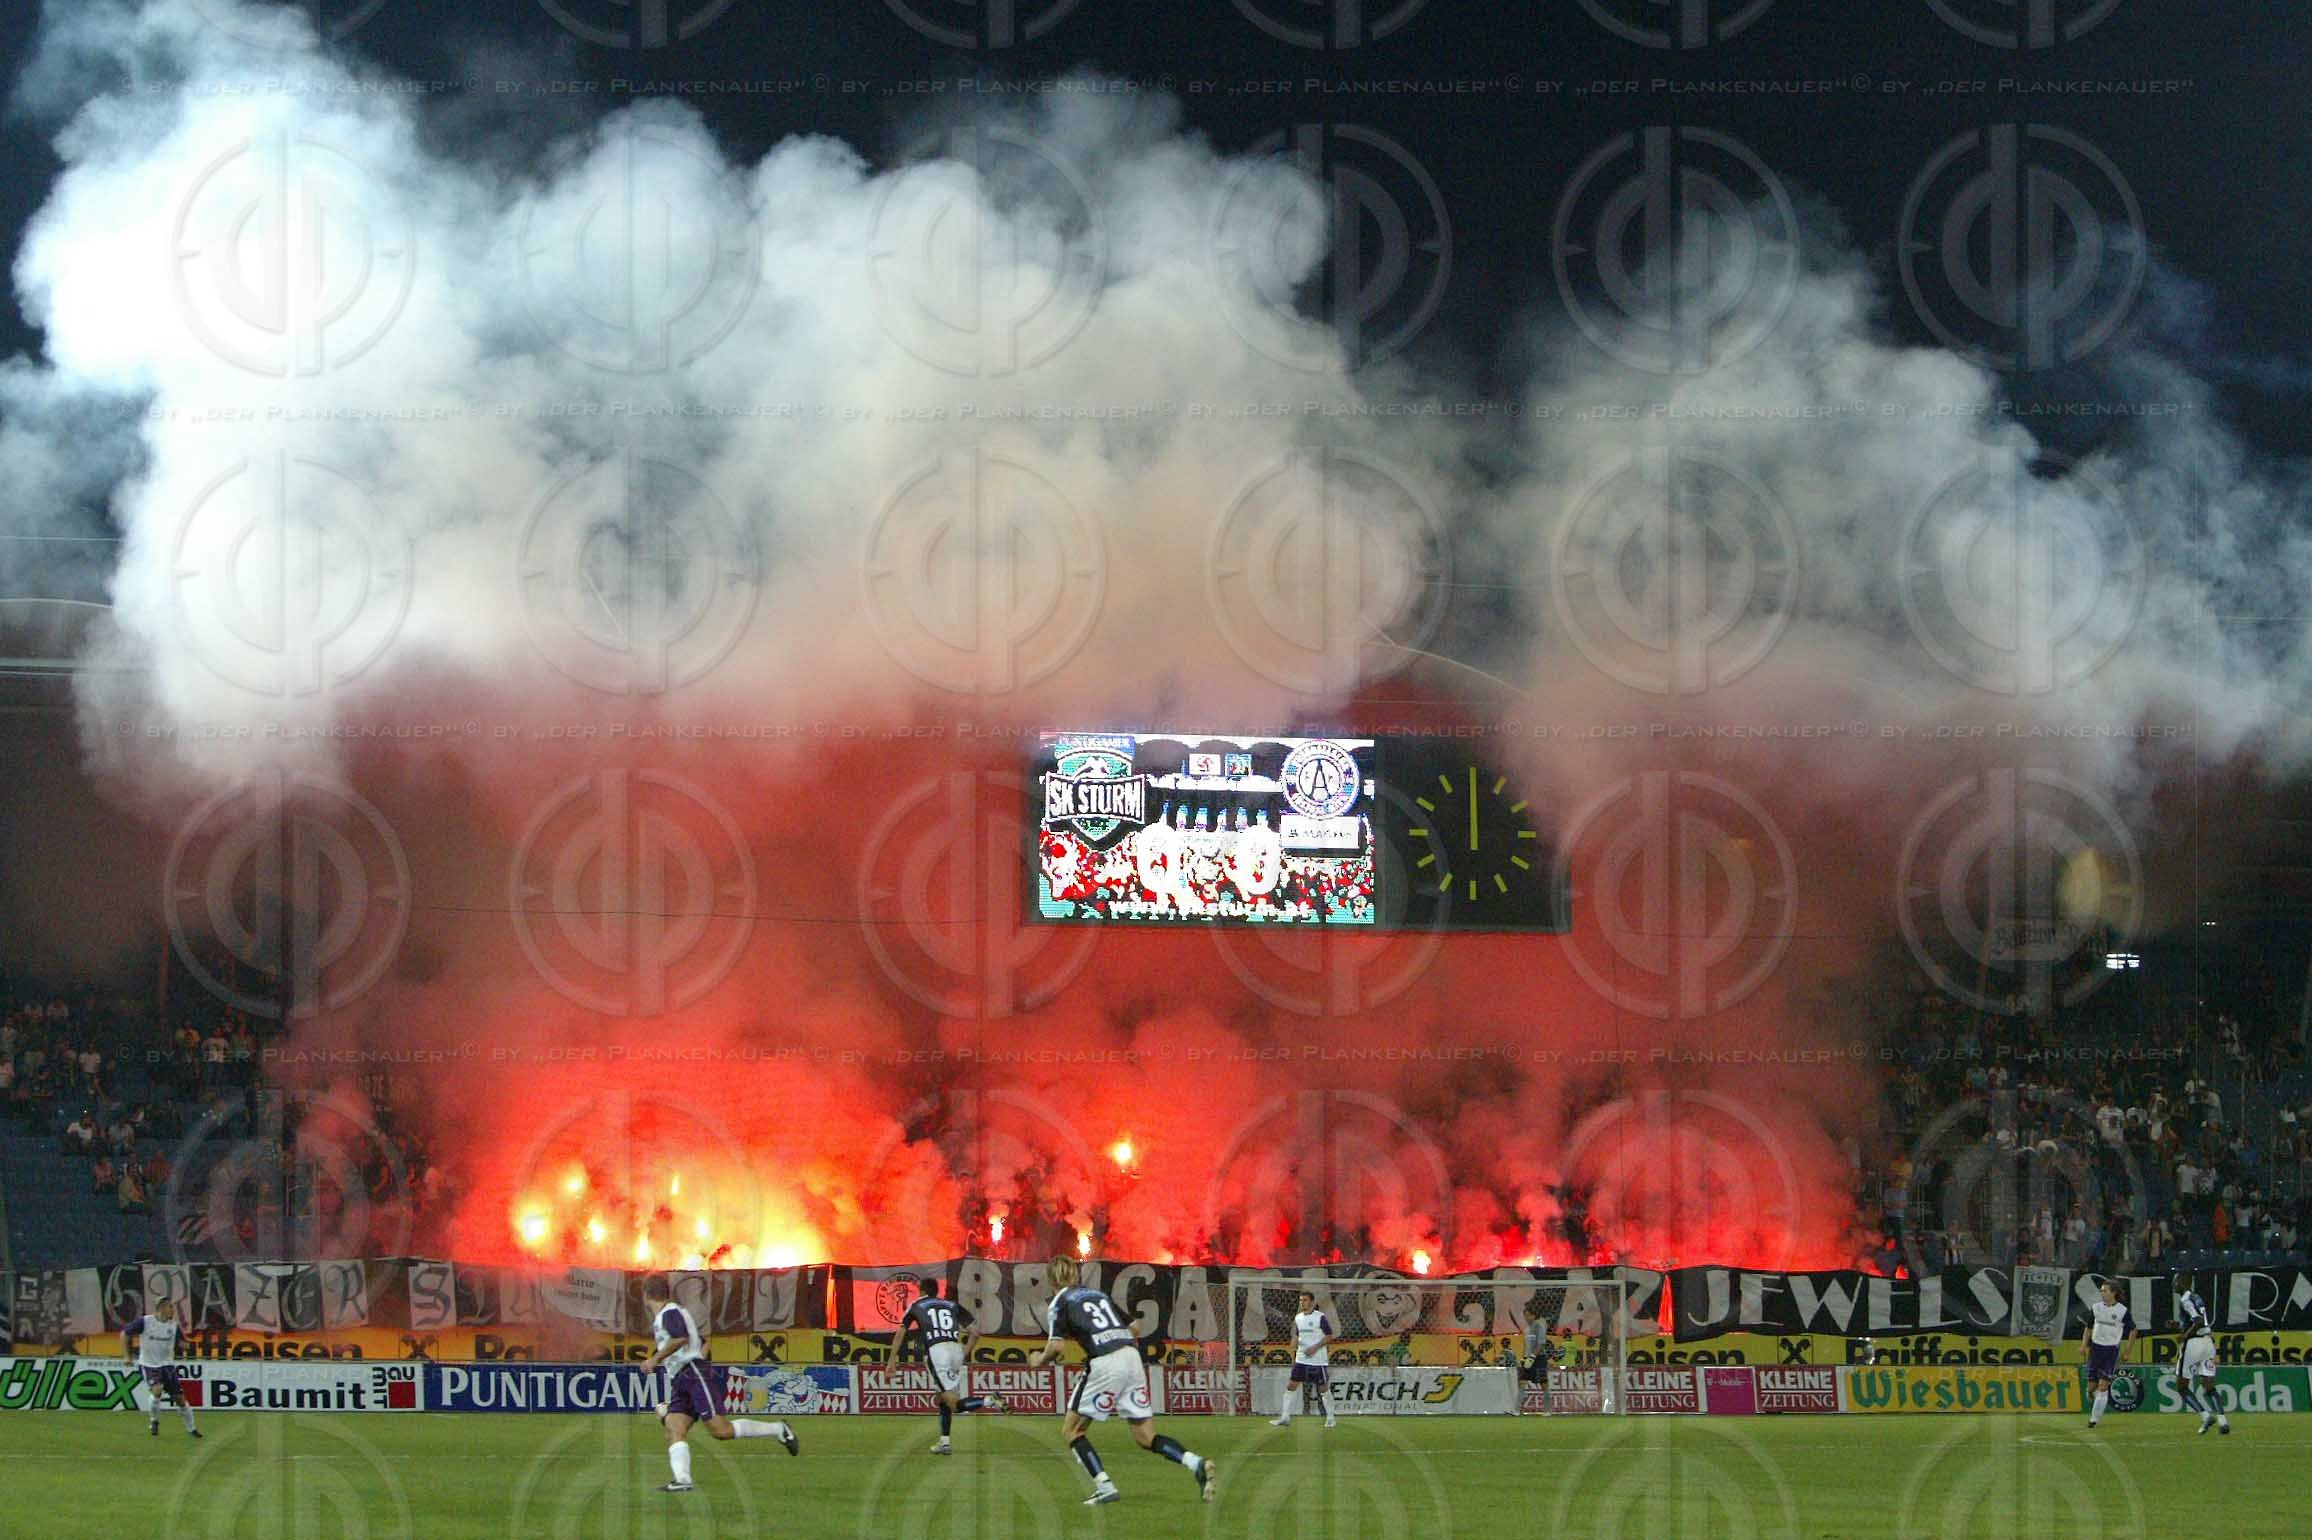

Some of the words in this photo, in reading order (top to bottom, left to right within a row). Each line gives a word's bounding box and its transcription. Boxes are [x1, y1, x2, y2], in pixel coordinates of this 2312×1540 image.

[1078, 780, 1141, 822] STURM
[1082, 1298, 1121, 1329] 31
[1687, 1267, 2010, 1332] JEWELS
[927, 1308, 954, 1330] 16
[0, 1359, 144, 1410] üllex
[210, 1379, 367, 1410] Baumit
[972, 1371, 1051, 1391] KLEINE
[1759, 1371, 1833, 1390] KLEINE
[1851, 1369, 2071, 1410] Wiesbauer
[1761, 1394, 1836, 1409] ZEITUNG
